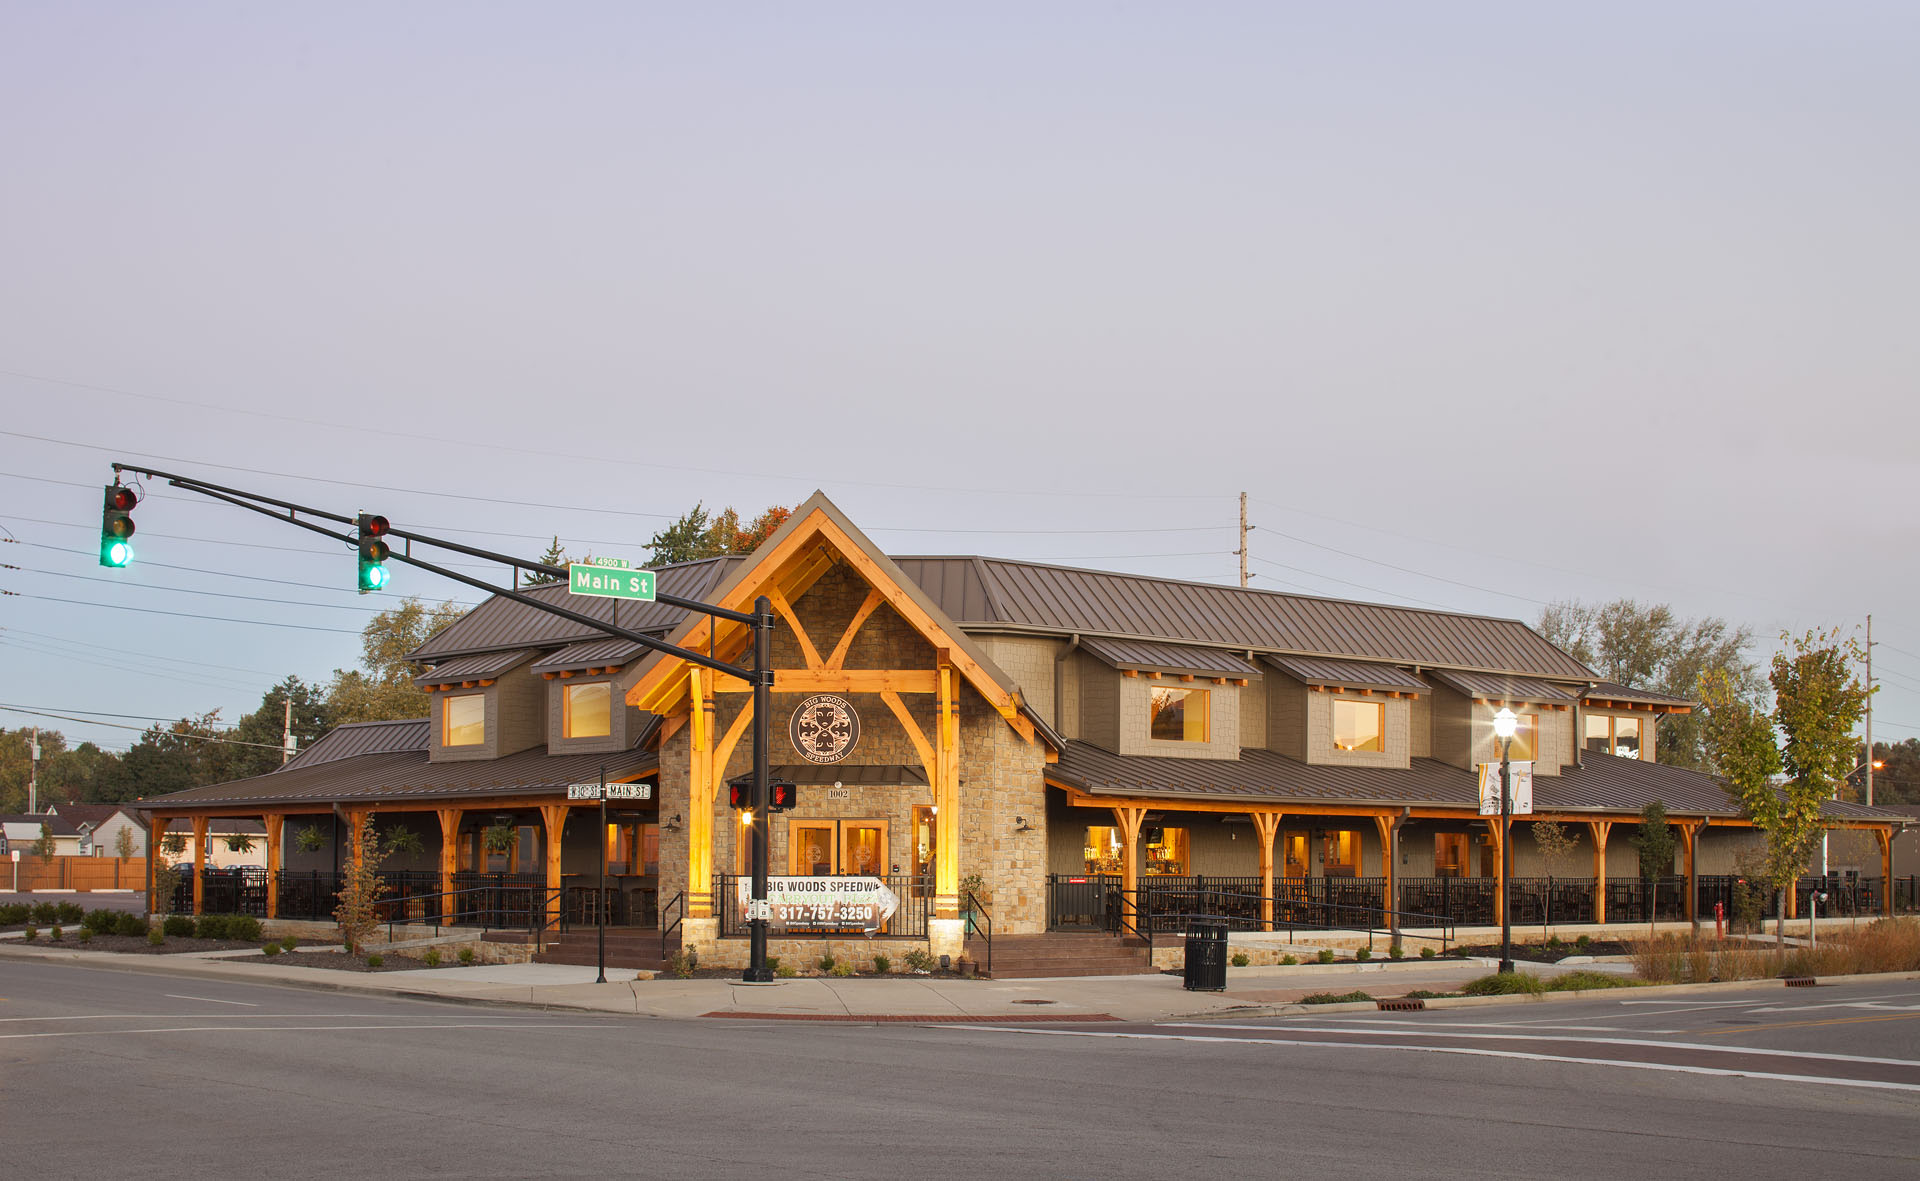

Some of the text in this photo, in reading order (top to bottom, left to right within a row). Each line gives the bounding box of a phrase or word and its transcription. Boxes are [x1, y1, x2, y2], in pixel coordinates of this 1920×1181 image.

[597, 558, 627, 568] 4900 W
[577, 572, 648, 593] Main St
[804, 696, 847, 709] BIG WOODS
[805, 752, 844, 763] SPEEDWAY
[610, 785, 646, 797] MAIN ST
[830, 790, 848, 798] 1002
[767, 881, 784, 892] BIG
[788, 881, 827, 892] WOODS
[779, 906, 873, 920] 317-757-3250
